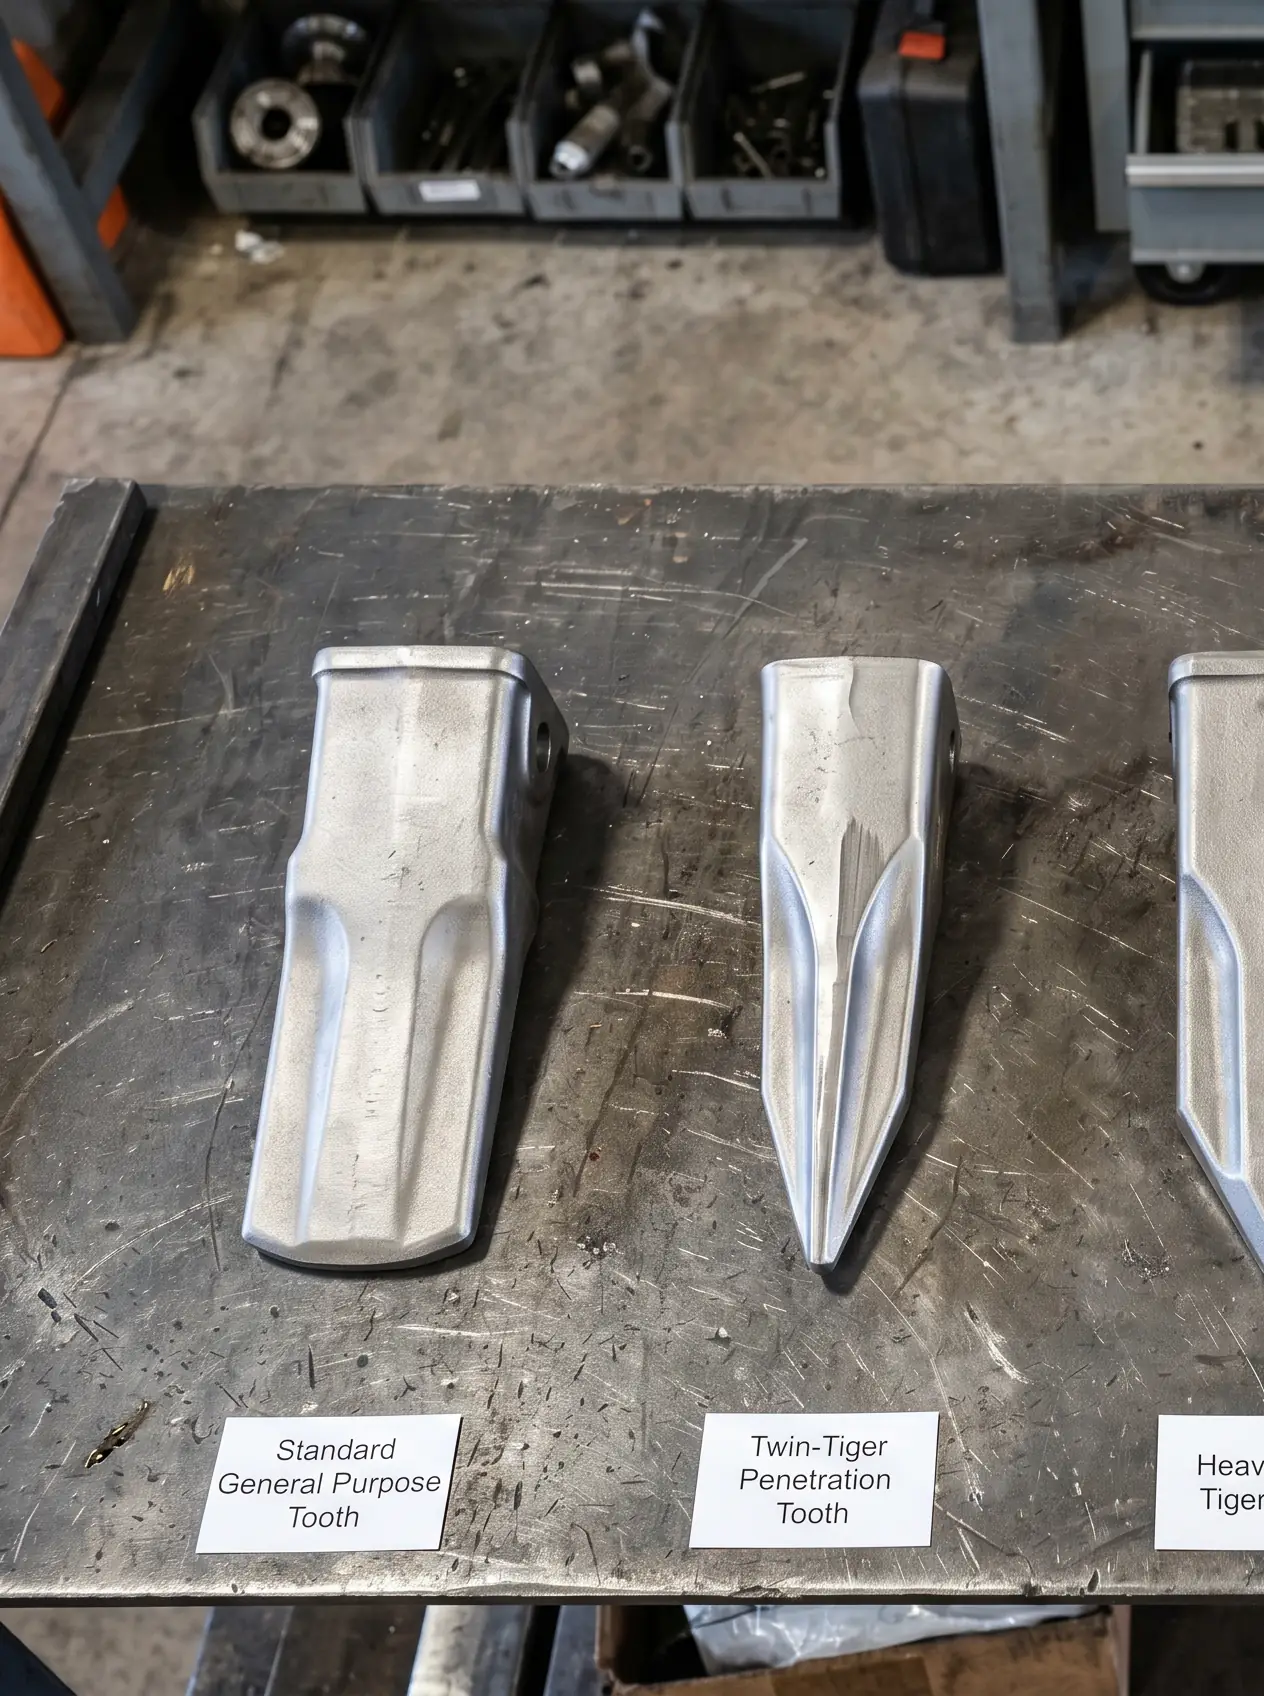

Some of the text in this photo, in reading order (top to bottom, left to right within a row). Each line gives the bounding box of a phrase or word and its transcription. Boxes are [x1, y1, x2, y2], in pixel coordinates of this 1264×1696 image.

[276, 1437, 397, 1461] Standard
[751, 1435, 888, 1463] Twin-Tiger
[218, 1472, 441, 1499] General Purpose
[739, 1468, 891, 1491] Penetration
[289, 1505, 359, 1528] Tooth
[776, 1501, 848, 1524] Tooth
